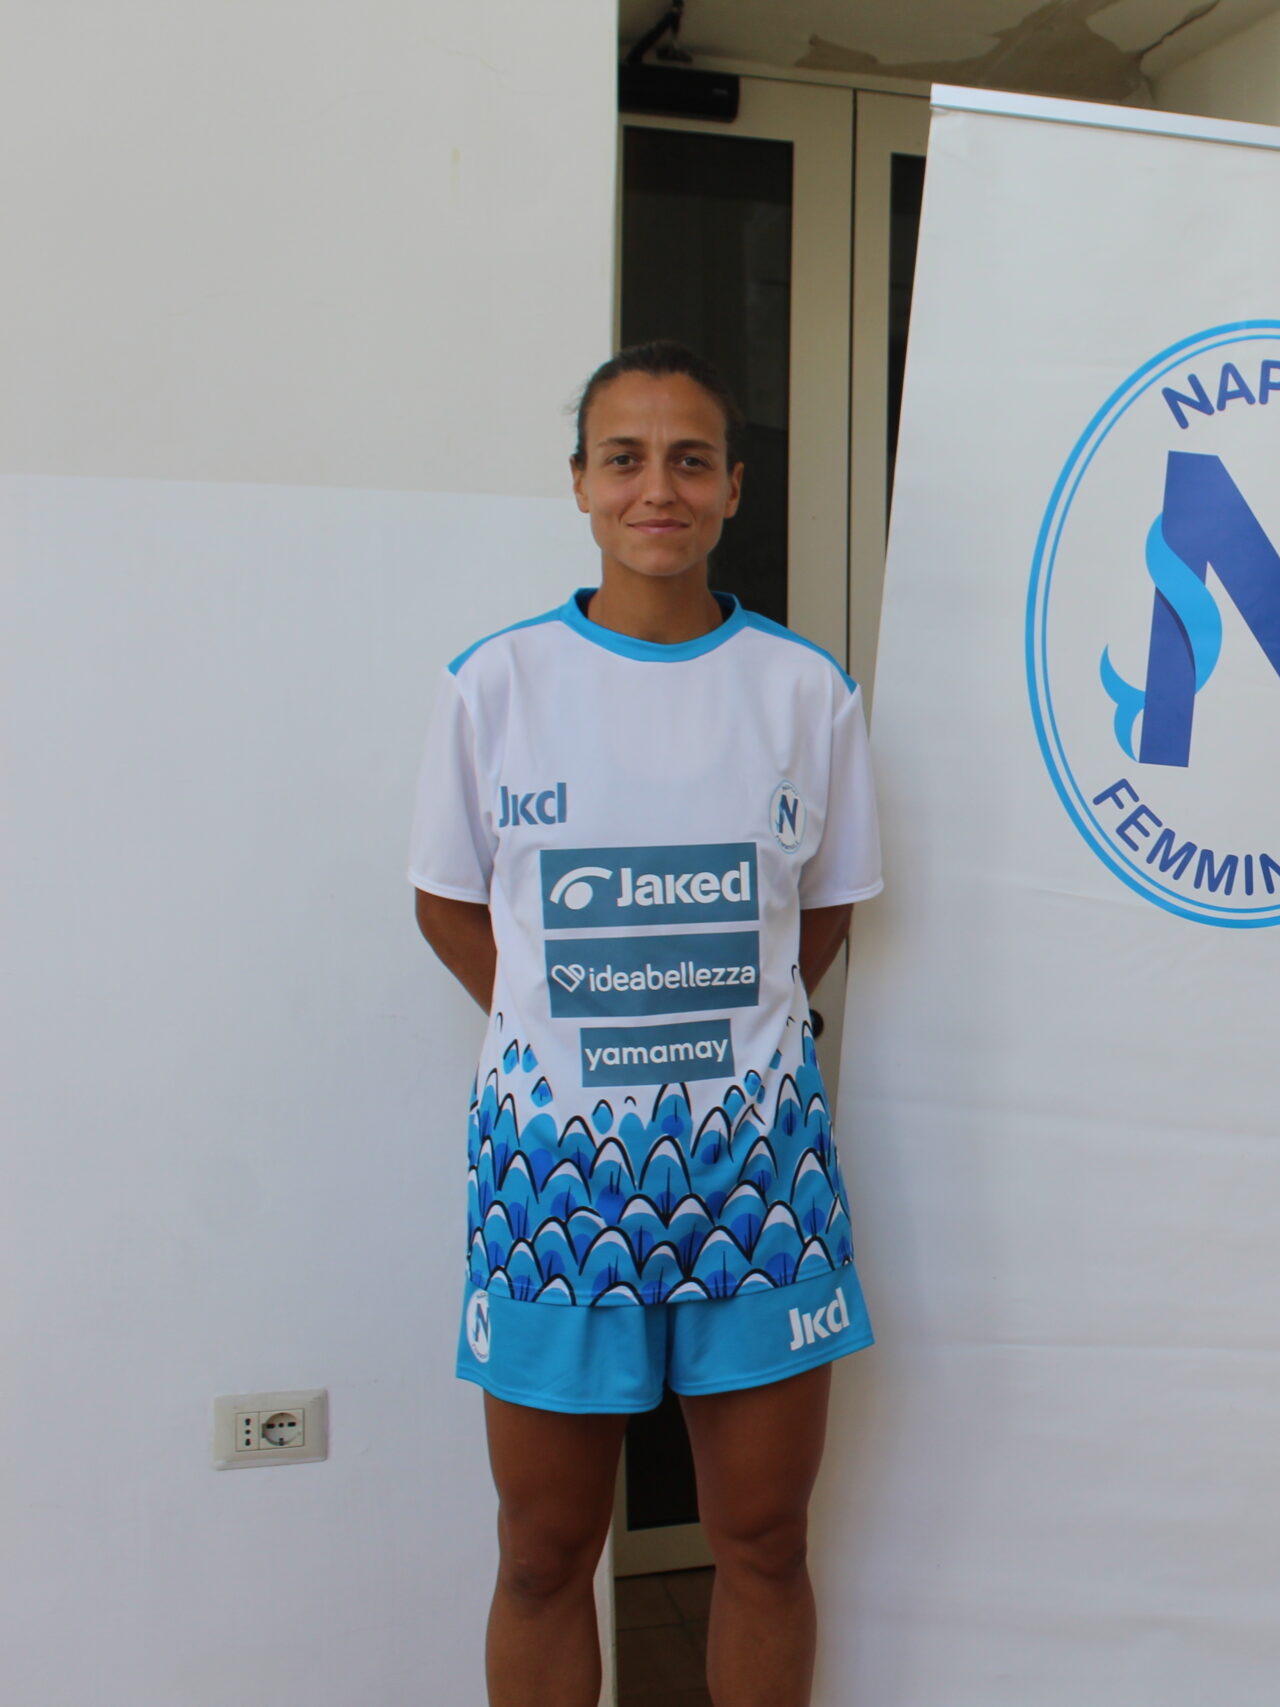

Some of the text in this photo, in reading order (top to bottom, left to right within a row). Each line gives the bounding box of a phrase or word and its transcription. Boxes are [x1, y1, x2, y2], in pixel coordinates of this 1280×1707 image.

[499, 781, 568, 828] Jkd
[616, 861, 751, 908] Jaked
[589, 960, 756, 993] ideabellezza
[585, 1038, 729, 1071] yamamay
[789, 1287, 850, 1351] Jkd
